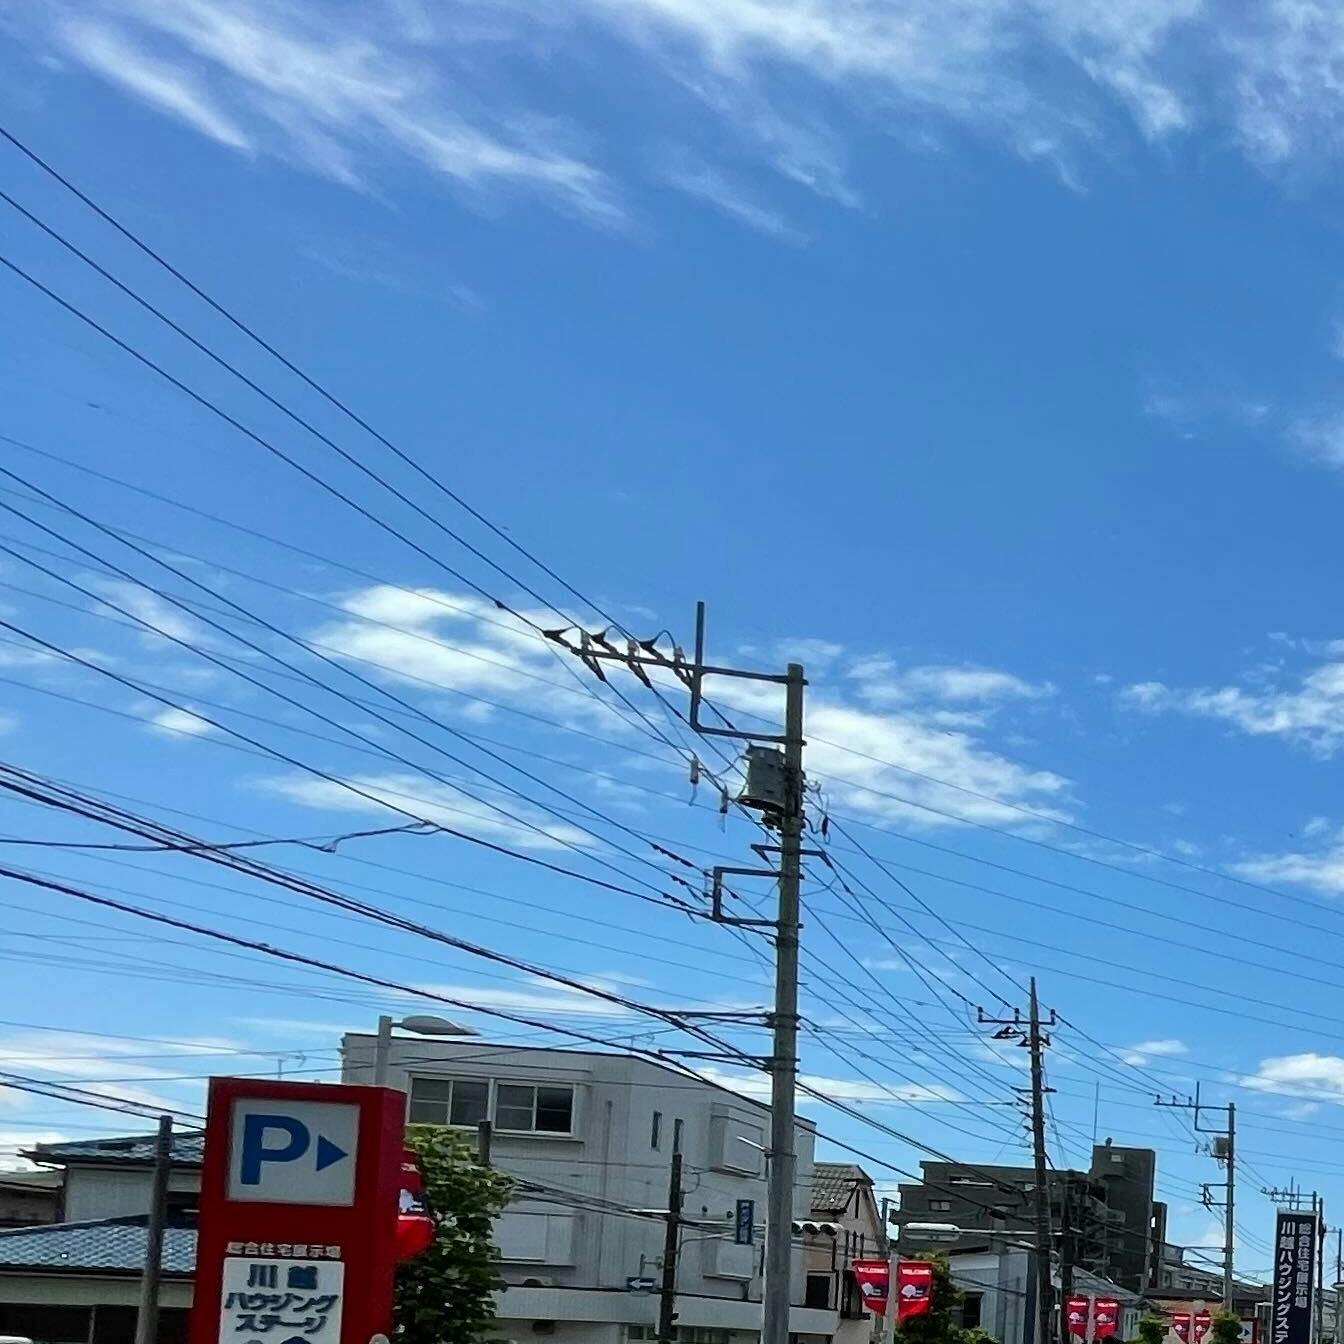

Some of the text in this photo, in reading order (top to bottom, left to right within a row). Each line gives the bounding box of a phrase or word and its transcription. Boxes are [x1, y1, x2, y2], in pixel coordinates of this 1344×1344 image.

[241, 1114, 310, 1185] P
[224, 1292, 339, 1313] ハウジング
[235, 1314, 327, 1334] ステージ
